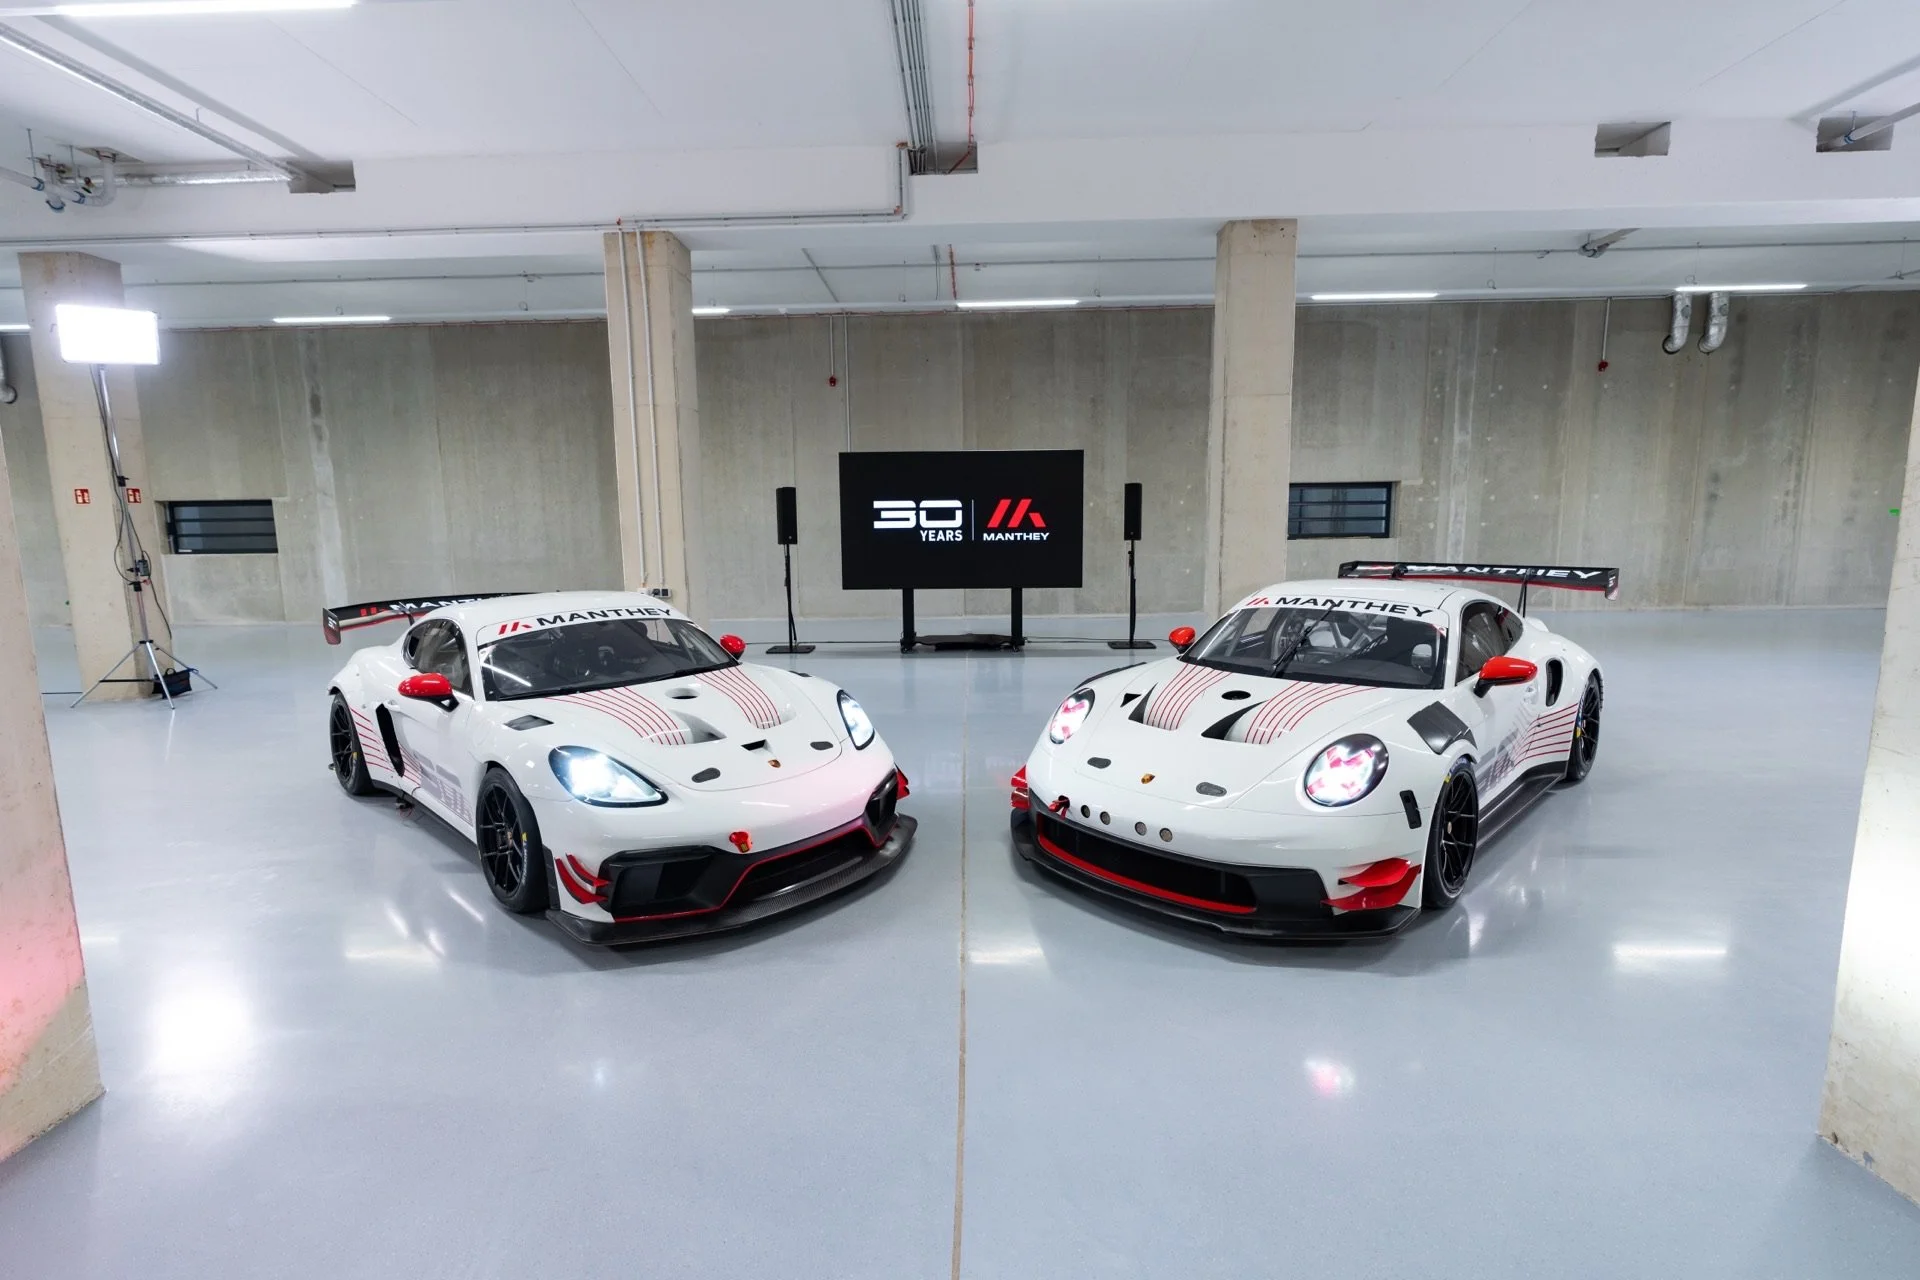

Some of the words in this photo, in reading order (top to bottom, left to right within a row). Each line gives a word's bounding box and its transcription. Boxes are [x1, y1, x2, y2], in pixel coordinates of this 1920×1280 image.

[873, 500, 962, 528] 30
[920, 530, 963, 541] YEARS
[983, 532, 1049, 541] MANTHEY
[1276, 597, 1433, 617] MANTHEY
[537, 608, 671, 626] MANTHEY
